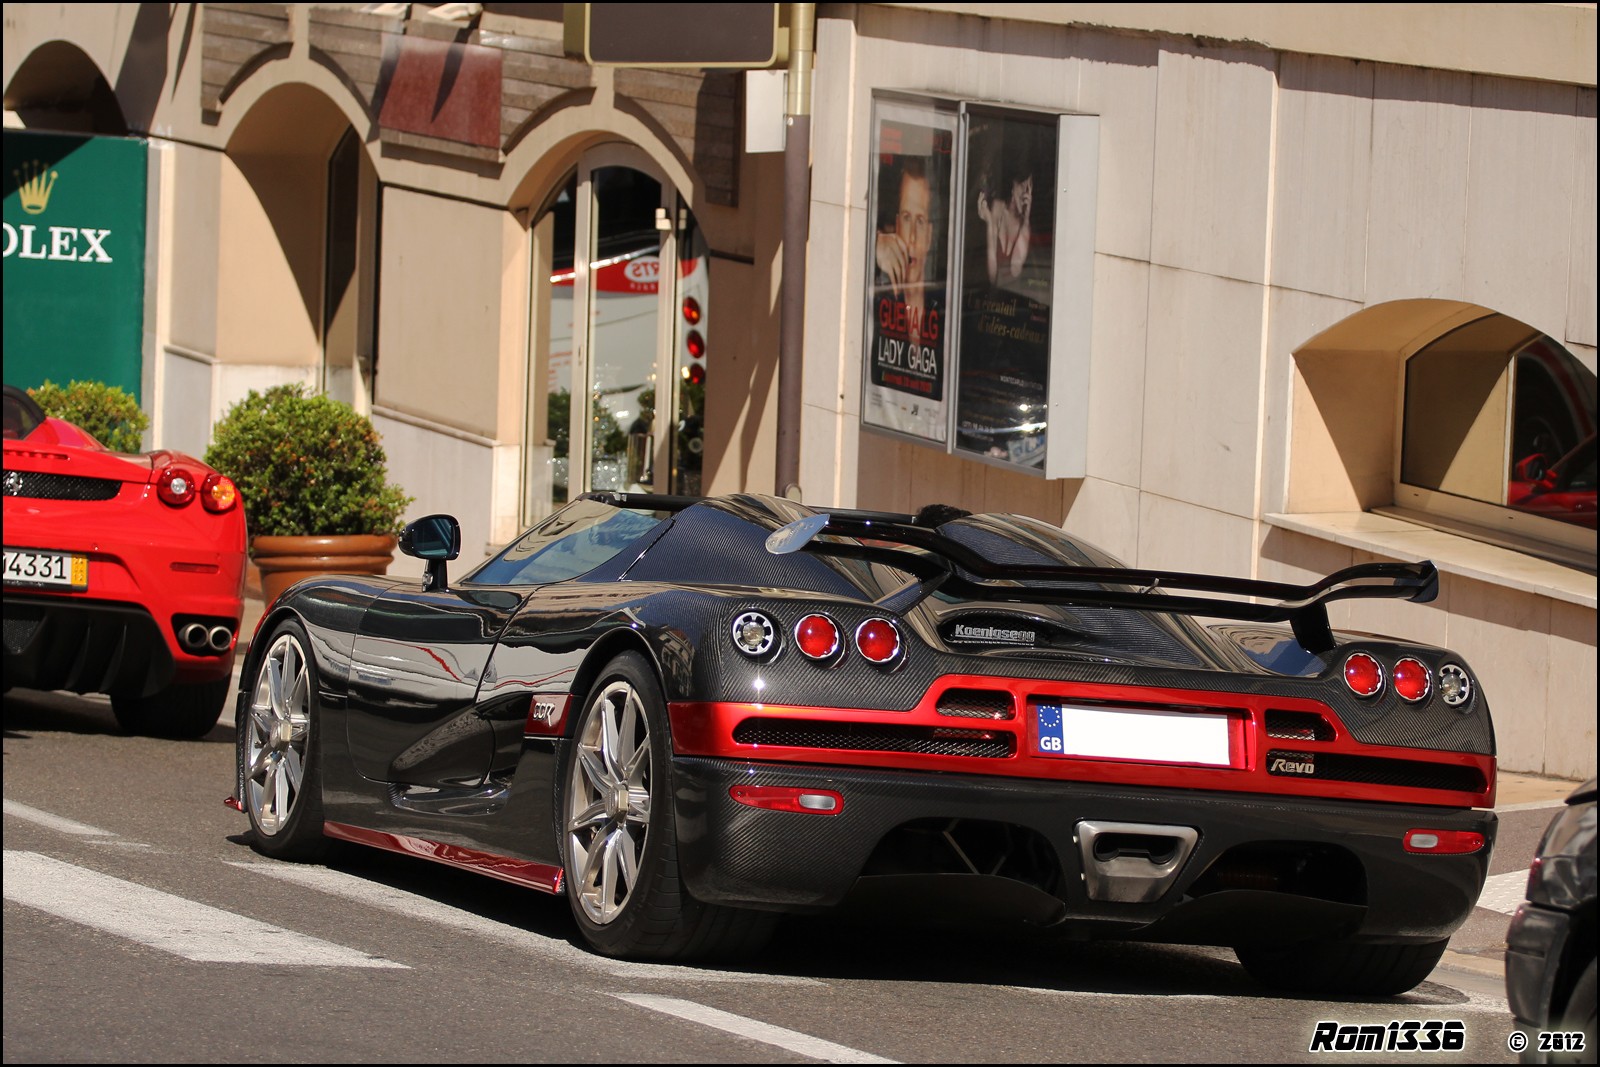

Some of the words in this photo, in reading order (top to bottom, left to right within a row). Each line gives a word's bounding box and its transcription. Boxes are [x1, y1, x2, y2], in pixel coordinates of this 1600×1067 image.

[878, 336, 904, 366] LADY
[907, 344, 937, 375] GAGA
[955, 624, 1035, 642] Koenigsegg
[1040, 736, 1062, 751] GB
[1270, 758, 1315, 774] Revo
